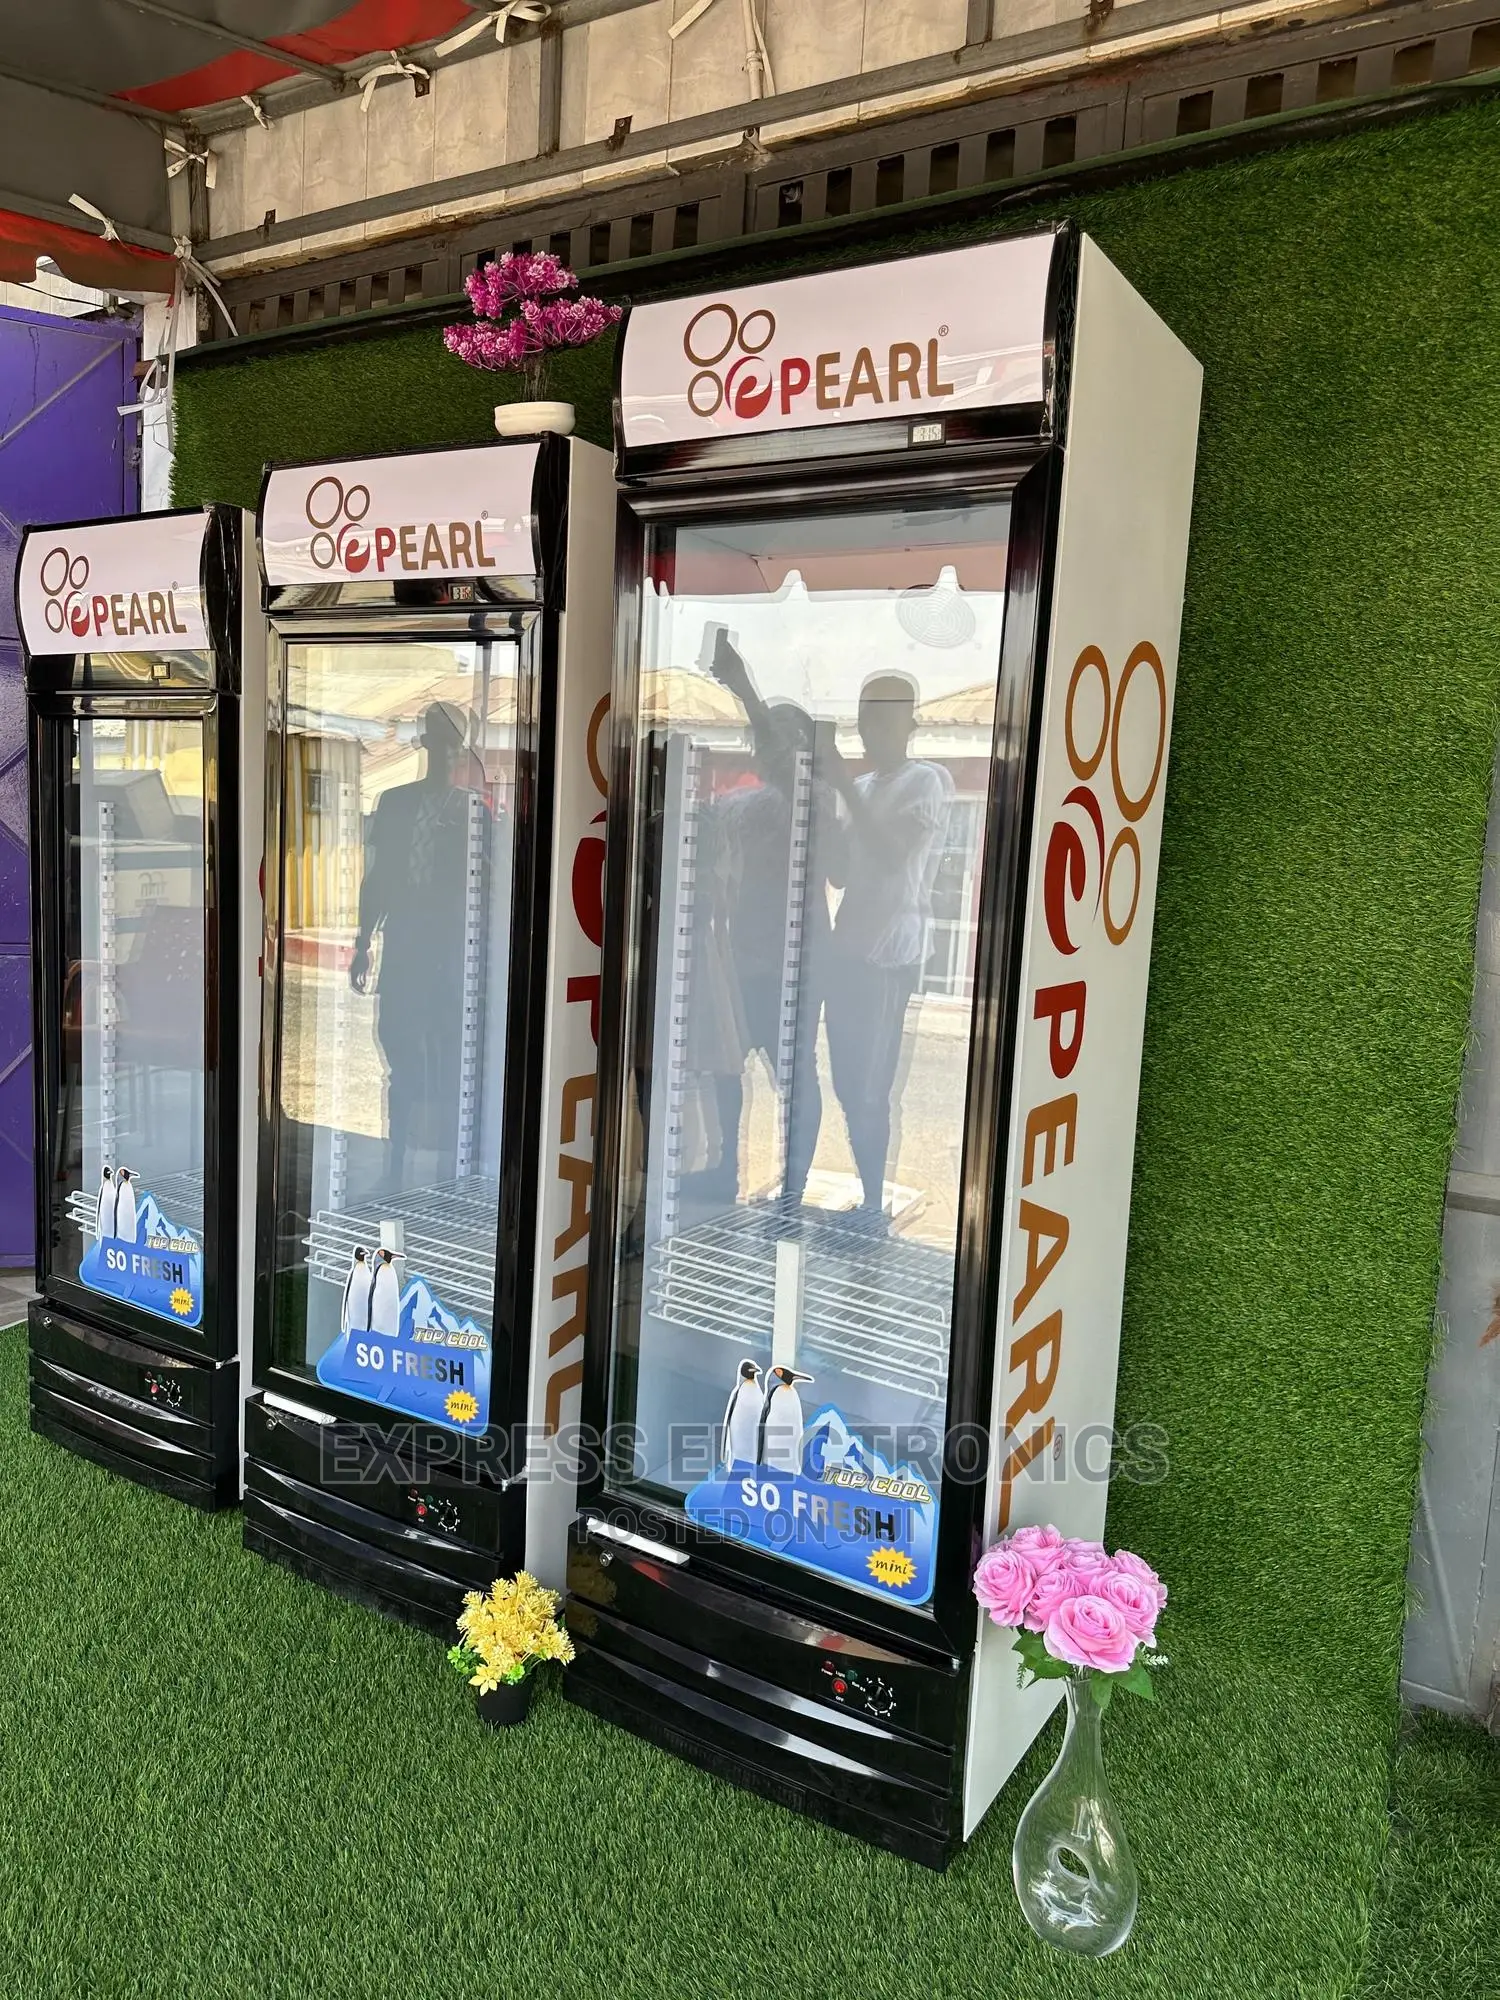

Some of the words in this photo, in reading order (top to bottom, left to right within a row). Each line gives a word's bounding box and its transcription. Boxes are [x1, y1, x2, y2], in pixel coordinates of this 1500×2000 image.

[780, 338, 954, 415] PEARL
[376, 519, 496, 573] PEARL
[93, 590, 187, 637] PEARL
[146, 1235, 168, 1250] TOP
[169, 1238, 200, 1254] COOL
[998, 980, 1087, 1536] PEARL
[106, 1248, 128, 1272] SO
[132, 1253, 185, 1285] FRESH
[171, 1293, 191, 1307] mini
[413, 1326, 445, 1346] TOP
[446, 1330, 488, 1351] COOL
[356, 1342, 384, 1371] SO
[392, 1351, 465, 1386] FRESH
[449, 1398, 475, 1413] mini
[822, 1465, 866, 1490] TOP
[869, 1475, 932, 1504] COOL
[741, 1477, 782, 1512] SO
[793, 1491, 896, 1542] FRESH
[875, 1555, 909, 1576] mini
